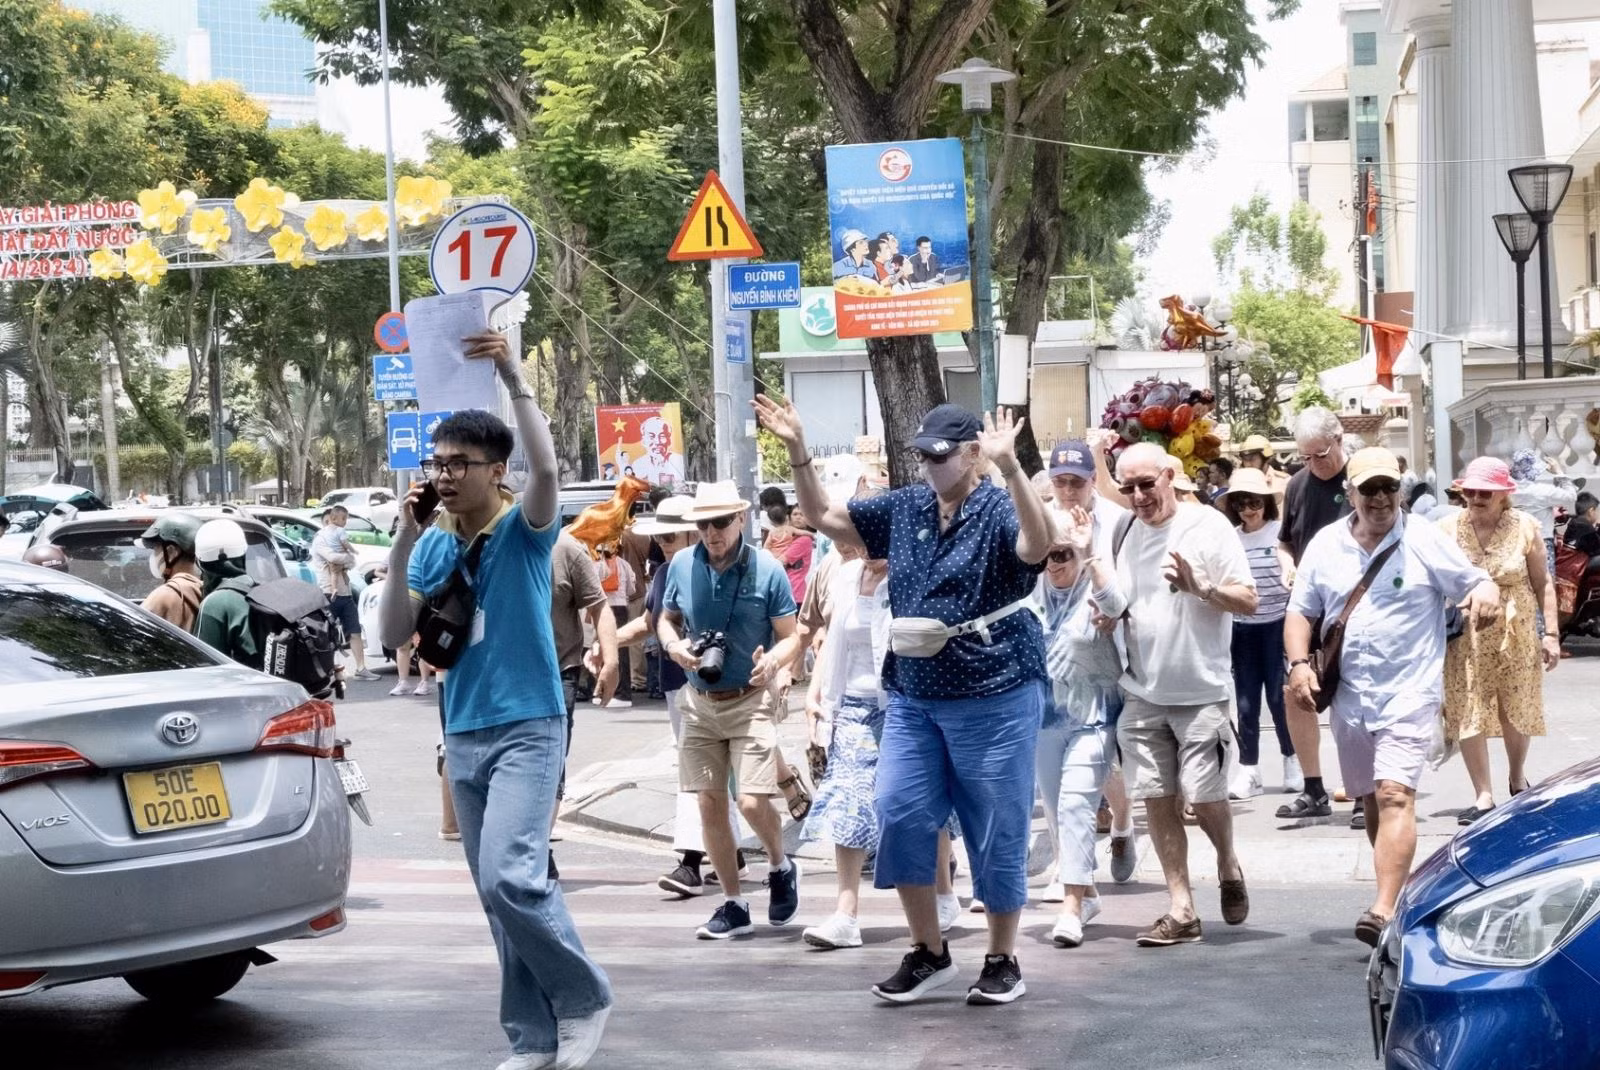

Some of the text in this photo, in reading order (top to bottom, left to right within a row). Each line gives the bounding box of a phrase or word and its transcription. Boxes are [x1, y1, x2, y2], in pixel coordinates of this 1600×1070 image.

[22, 200, 59, 223] GIẢI
[66, 199, 135, 221] PHÓNG
[33, 226, 69, 250] ĐẤT
[77, 224, 134, 248] NƯỚC
[448, 225, 517, 280] 17
[744, 269, 785, 283] ĐƯỜNG
[152, 768, 198, 797] 50E
[20, 813, 71, 831] VIOS
[143, 794, 221, 827] 020.00
